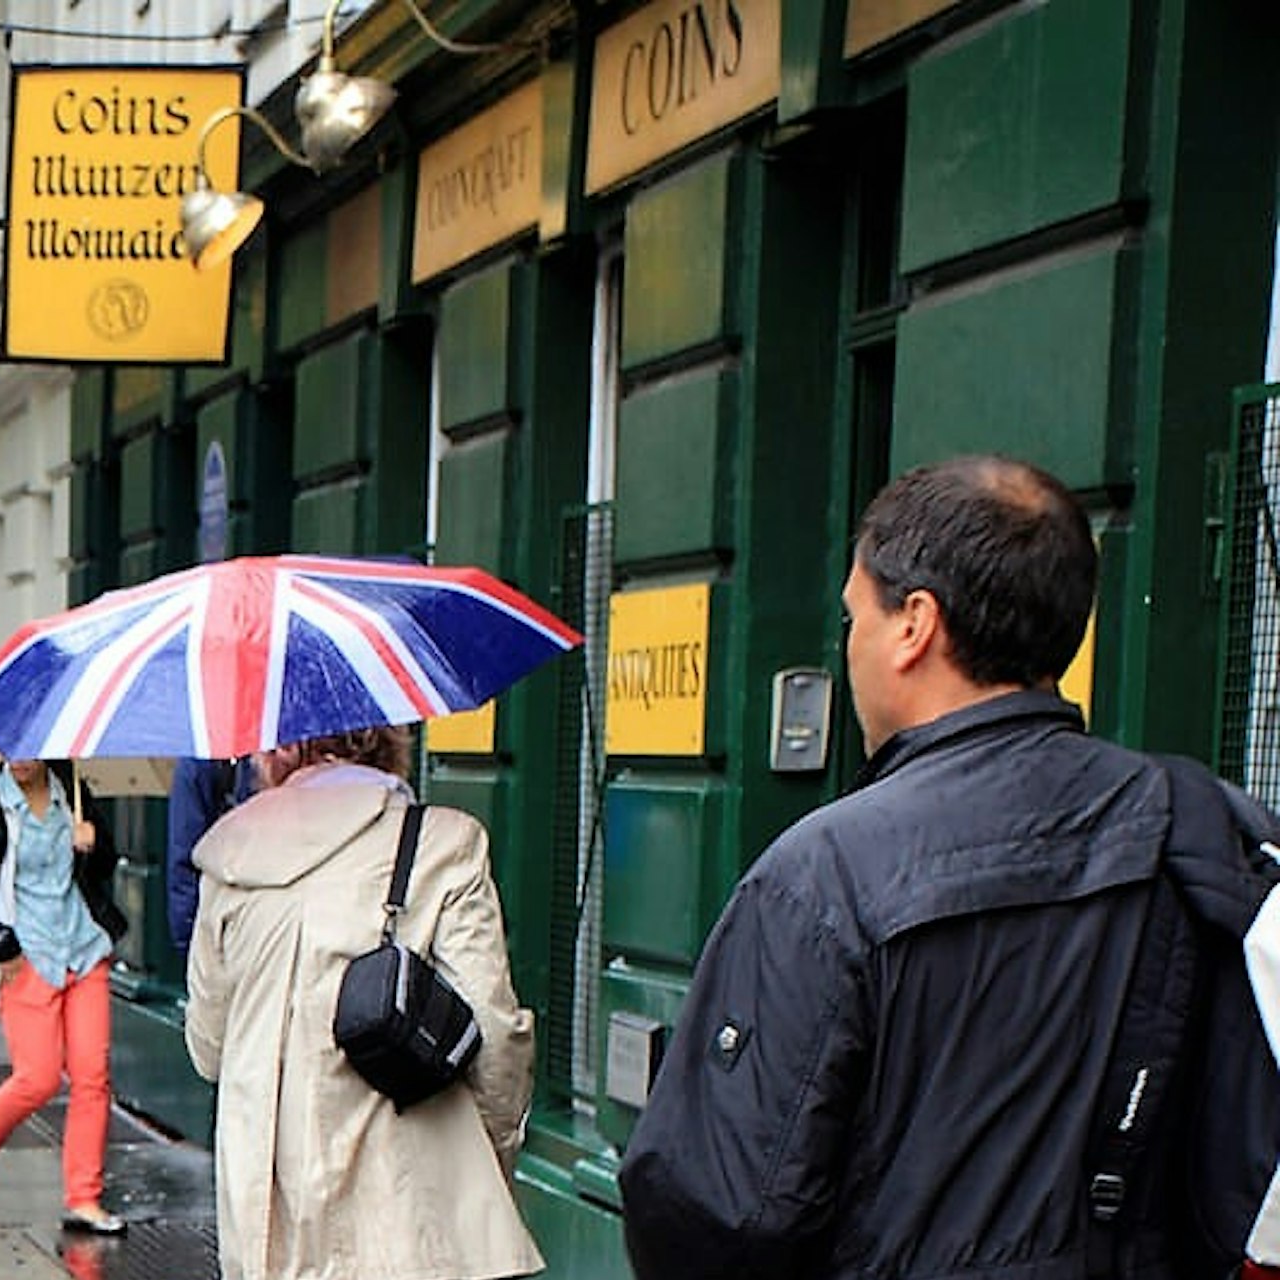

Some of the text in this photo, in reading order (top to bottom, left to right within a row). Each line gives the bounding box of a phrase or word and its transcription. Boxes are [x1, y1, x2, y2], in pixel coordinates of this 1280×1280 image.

[623, 0, 742, 135] COINS
[52, 86, 190, 135] Coins
[610, 642, 702, 711] ANTIQUITIES
